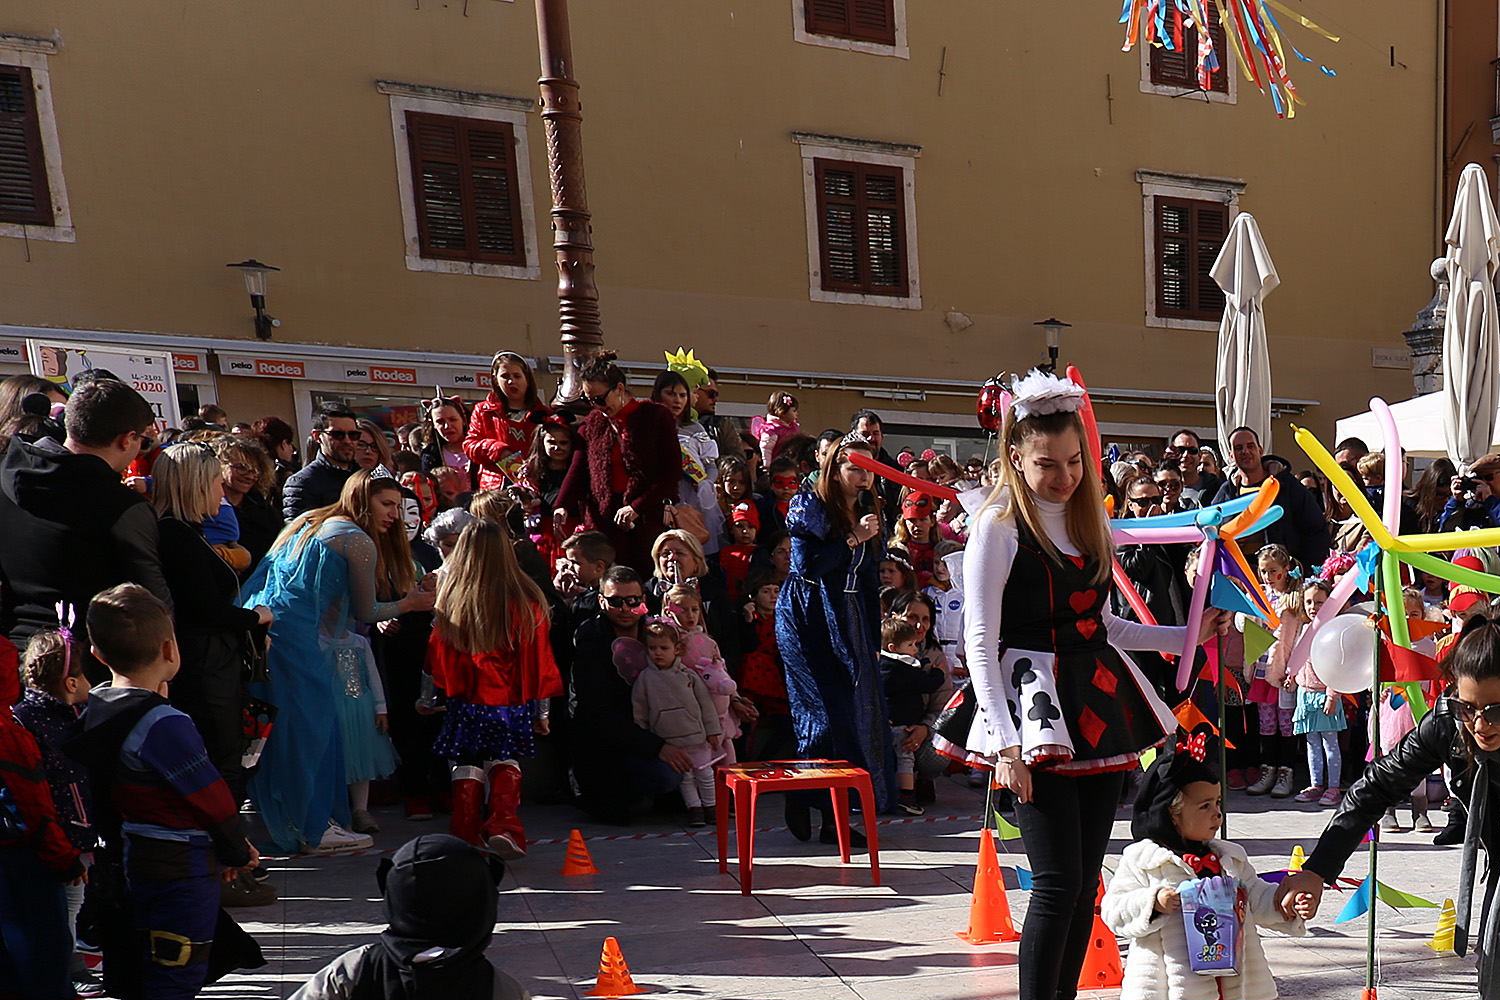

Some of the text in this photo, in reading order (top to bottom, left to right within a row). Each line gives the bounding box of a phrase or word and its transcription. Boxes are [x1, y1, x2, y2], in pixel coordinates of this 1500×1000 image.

[231, 361, 302, 375] peko Rodea
[346, 369, 414, 382] peko Rodea
[455, 375, 474, 383] peko
[133, 381, 167, 393] 2020.
[1203, 944, 1224, 956] POP
